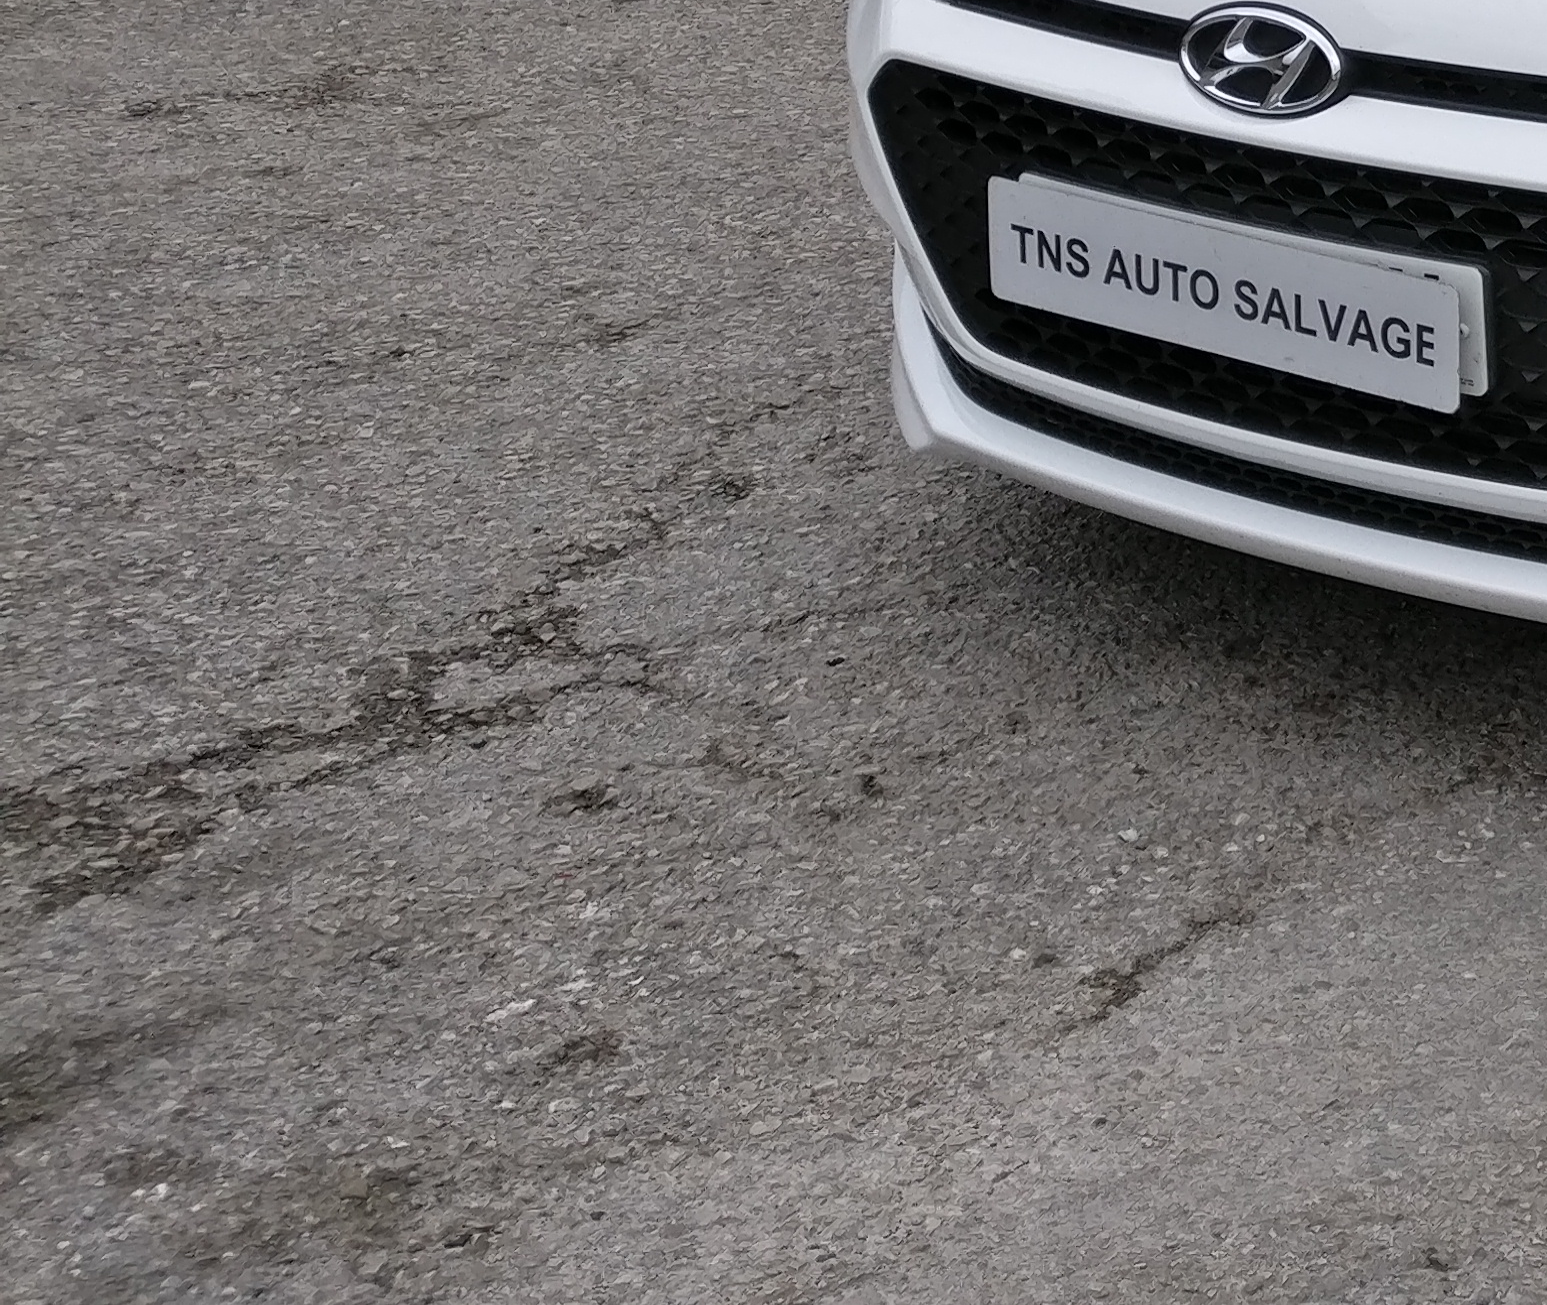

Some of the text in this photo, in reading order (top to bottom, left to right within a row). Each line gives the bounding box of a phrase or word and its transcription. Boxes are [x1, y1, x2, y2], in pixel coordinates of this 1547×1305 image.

[1010, 223, 1435, 368] TNS AUTO SALVAGE
